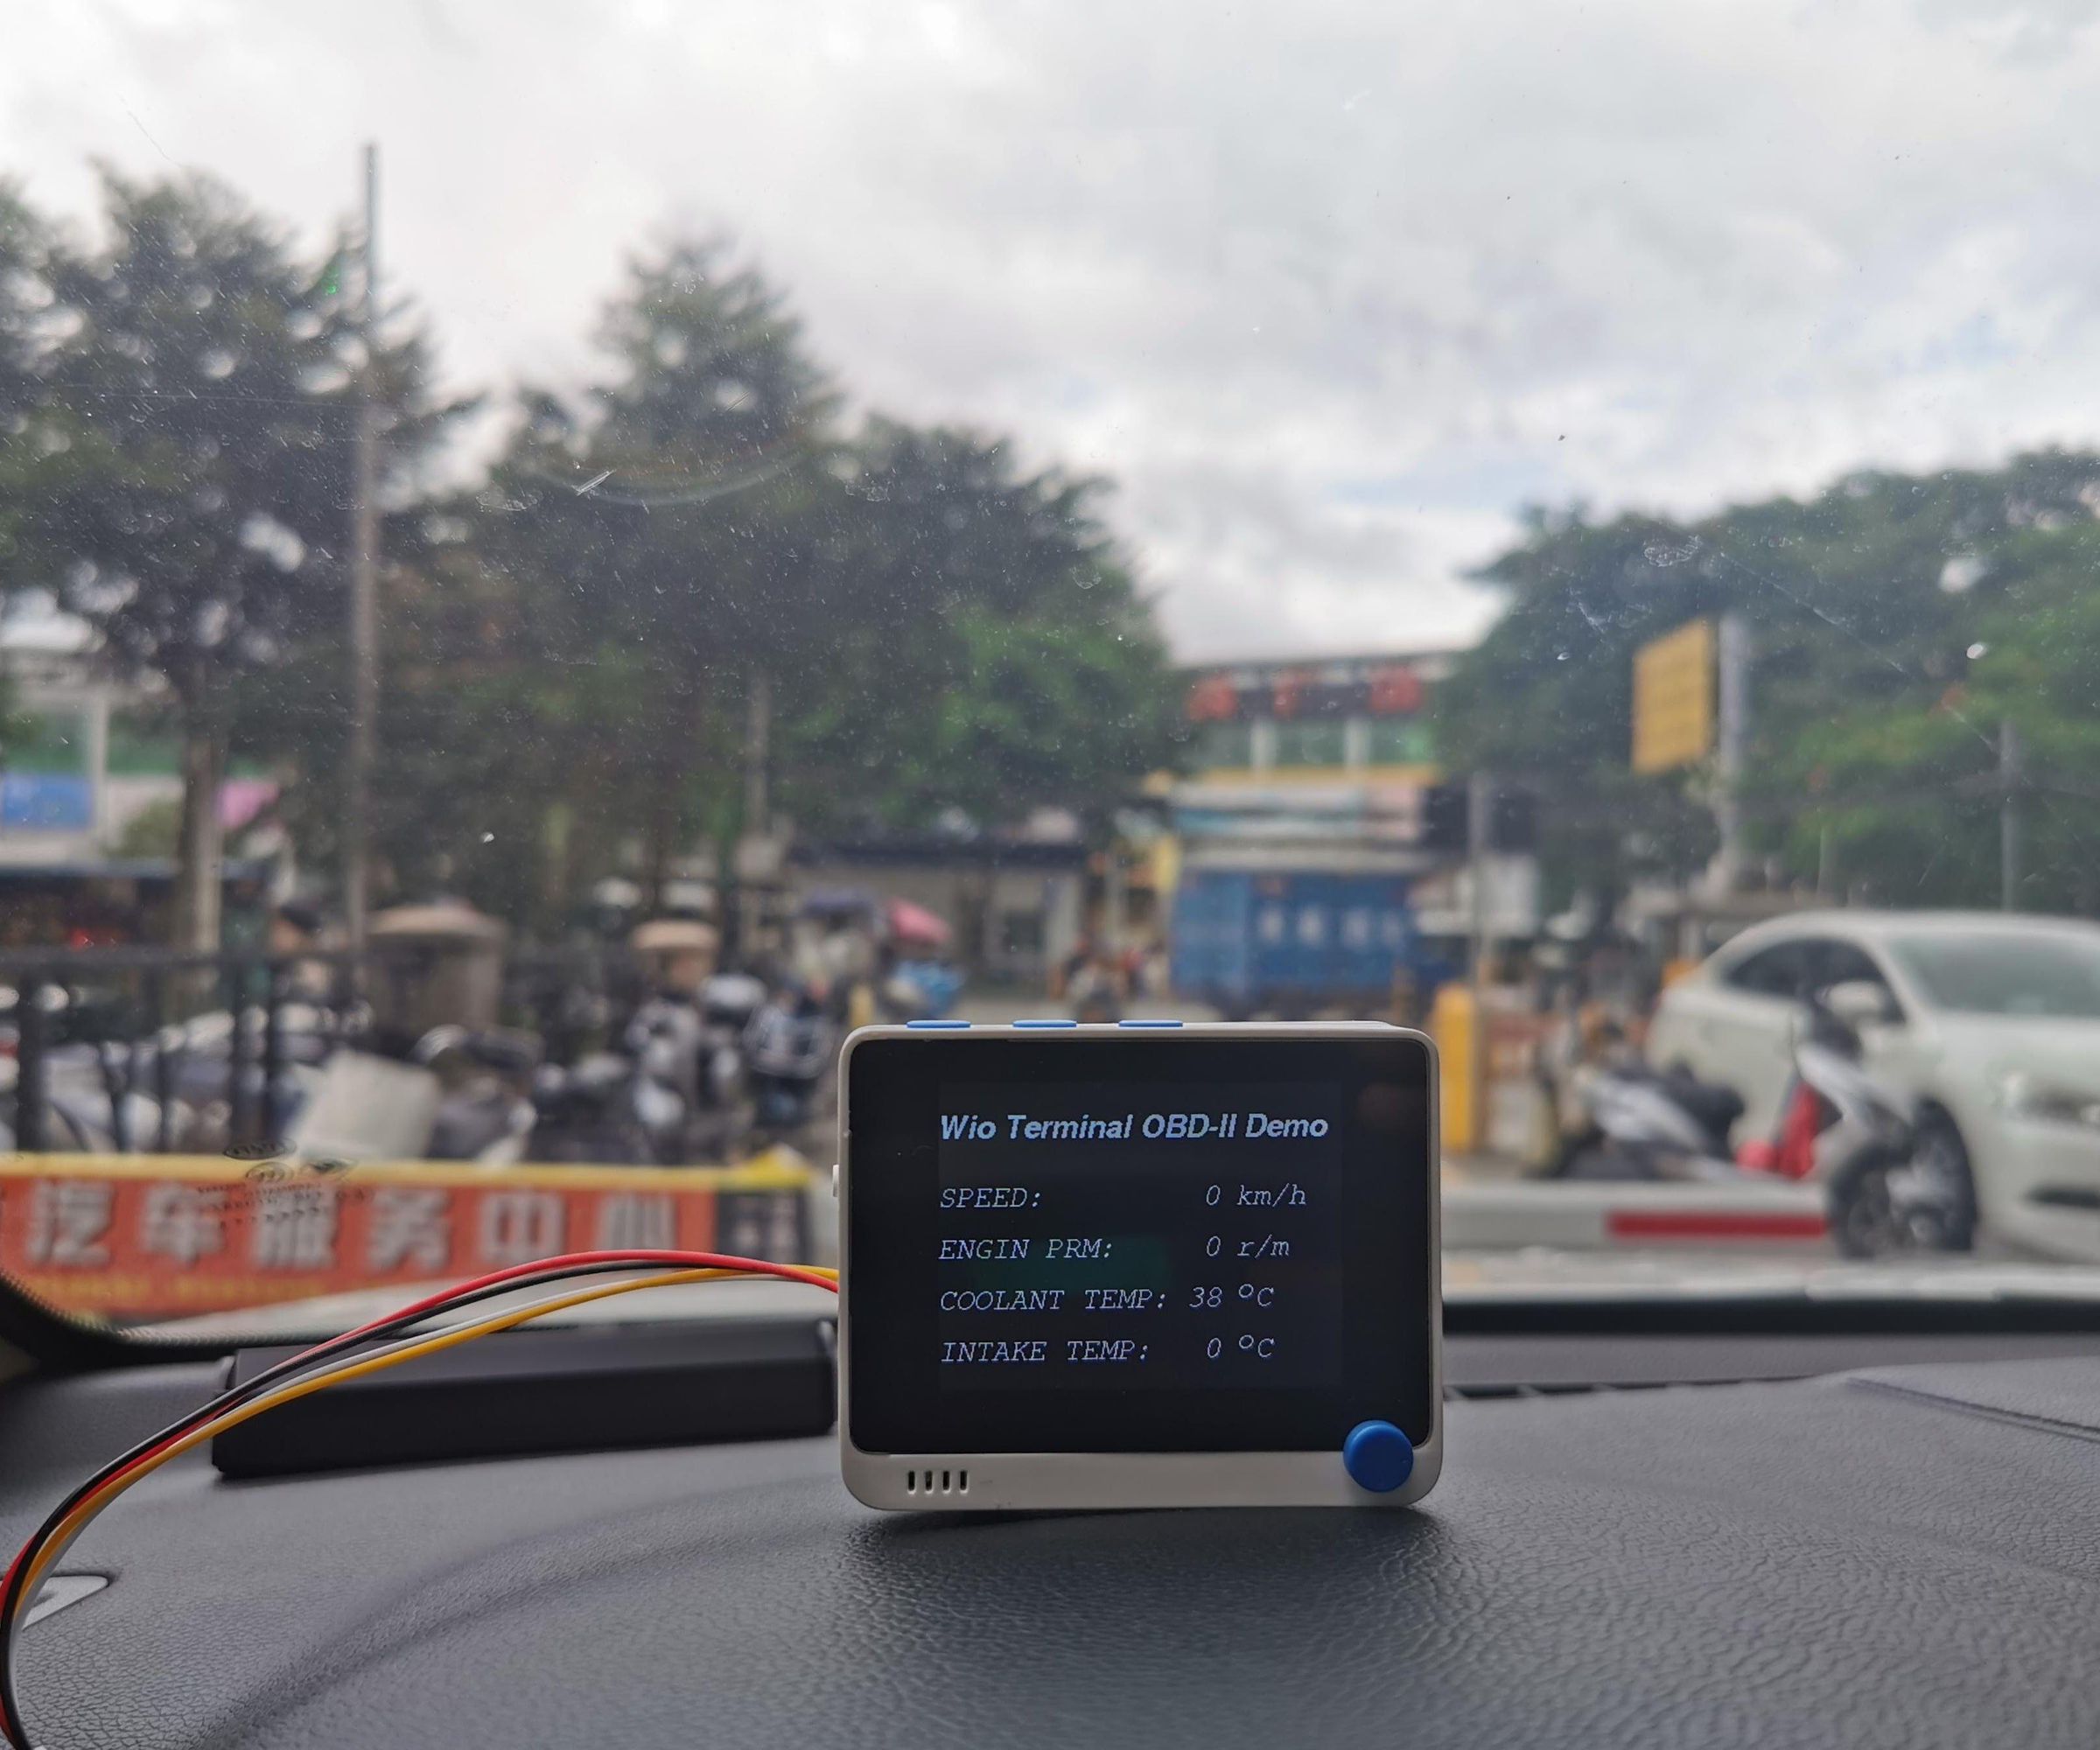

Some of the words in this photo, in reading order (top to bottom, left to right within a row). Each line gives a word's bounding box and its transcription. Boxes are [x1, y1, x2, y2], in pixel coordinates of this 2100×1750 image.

[941, 1114, 997, 1140] Wio
[1007, 1113, 1134, 1140] Terminal
[1141, 1112, 1237, 1139] OBD-II
[1244, 1113, 1329, 1138] Demo
[940, 1187, 1041, 1208] SPEED:
[1206, 1184, 1222, 1207] 0
[1236, 1182, 1306, 1208] km/h
[937, 1239, 1031, 1260] ENGIN
[1045, 1238, 1112, 1259] PRM:
[1206, 1236, 1222, 1257] 0
[1236, 1234, 1290, 1259] r/m
[940, 1289, 1065, 1312] COOLANT
[1084, 1288, 1166, 1310] TEMP:
[1188, 1286, 1223, 1308] 38
[941, 1340, 1048, 1363] INTAKE
[1067, 1340, 1149, 1362] TEMP:
[1207, 1337, 1222, 1359] 0
